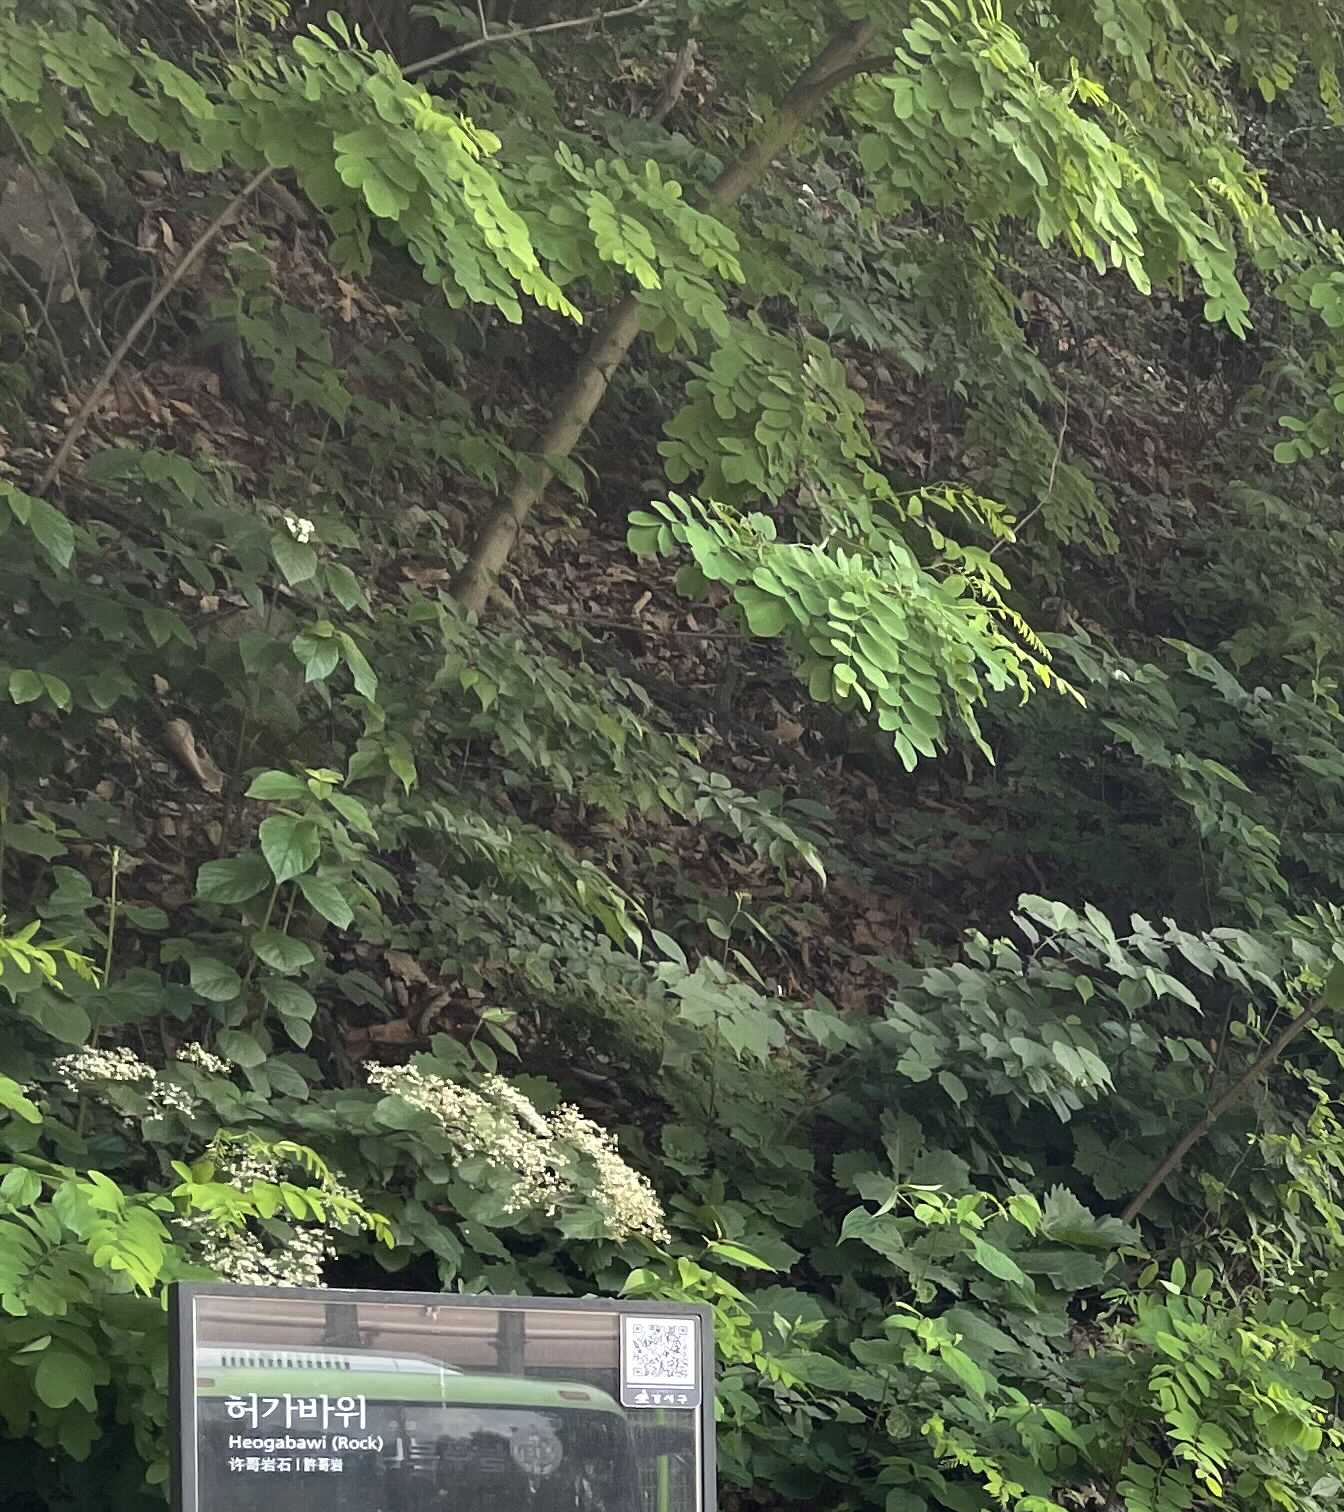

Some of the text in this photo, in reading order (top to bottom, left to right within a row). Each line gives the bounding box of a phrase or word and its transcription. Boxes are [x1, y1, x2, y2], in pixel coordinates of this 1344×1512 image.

[224, 1393, 366, 1429] 허가바위
[229, 1435, 383, 1452] Heogabawi (Rock)
